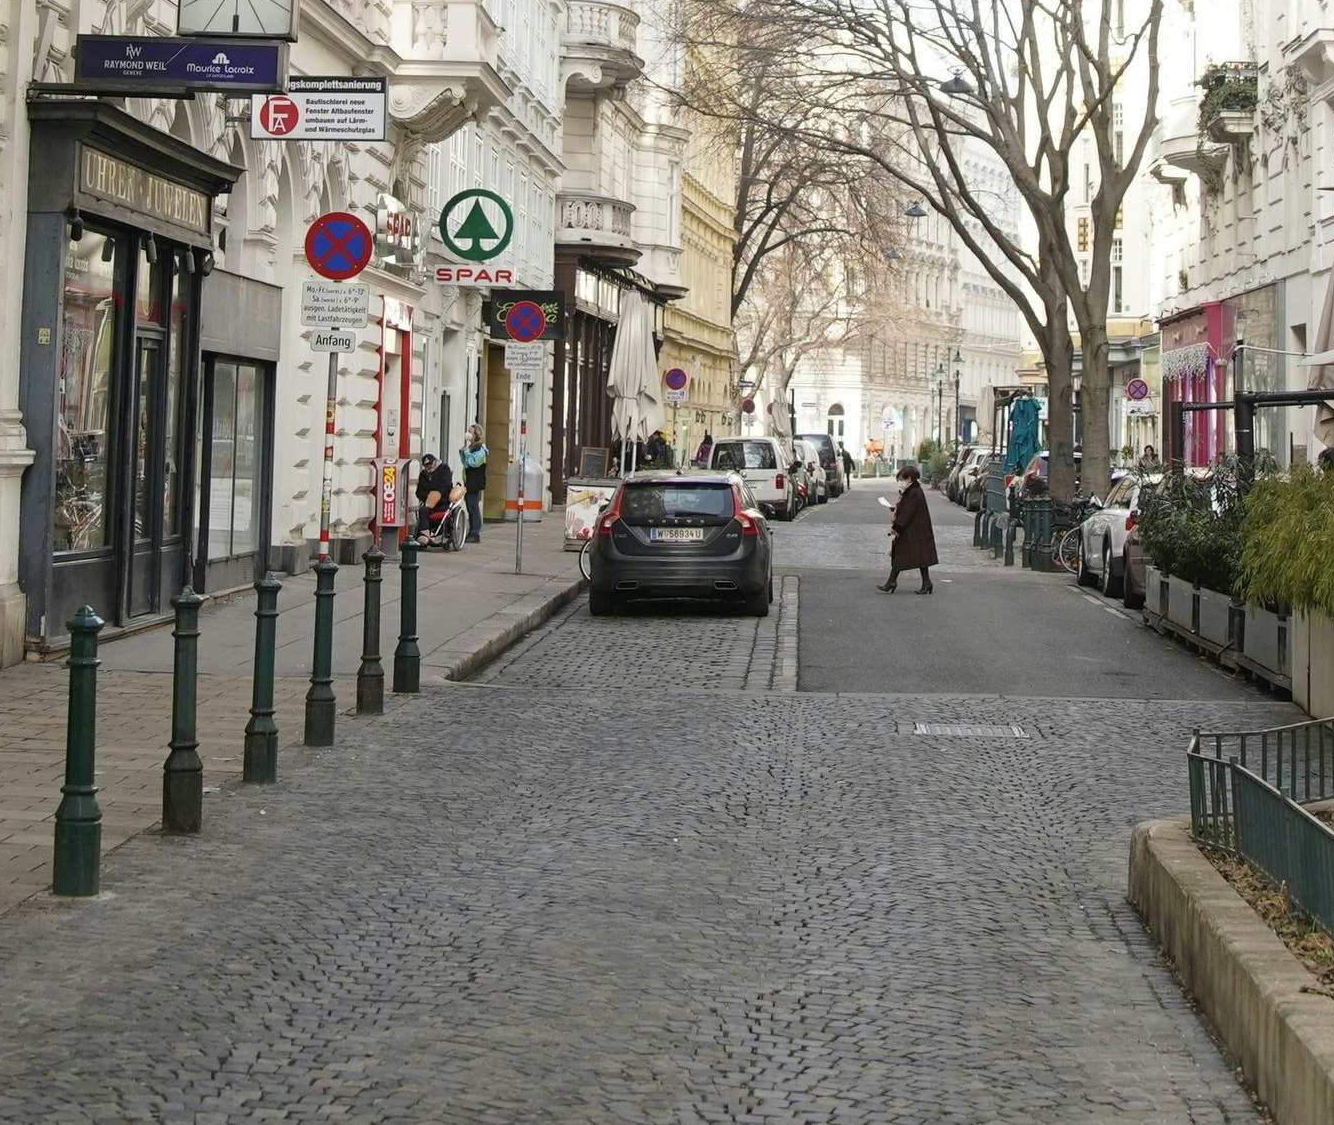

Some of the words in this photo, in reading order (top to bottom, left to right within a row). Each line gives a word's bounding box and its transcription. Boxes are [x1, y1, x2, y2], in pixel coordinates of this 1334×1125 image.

[104, 59, 144, 70] RAYMOND
[145, 61, 167, 71] WEIL
[186, 62, 221, 73] Maurice
[224, 64, 255, 74] Lacroix
[305, 98, 348, 106] Bautischlerei
[318, 126, 375, 134] Wärmeschutzglas
[86, 150, 136, 204] UHREN
[147, 176, 205, 226] JUWELEN
[436, 267, 513, 283] SPAR
[304, 305, 326, 313] ausgen.
[327, 305, 366, 314] Ladetätigkeit
[317, 315, 363, 325] Lastfahrzeugen
[315, 334, 351, 349] Anfang
[516, 372, 531, 380] Ende
